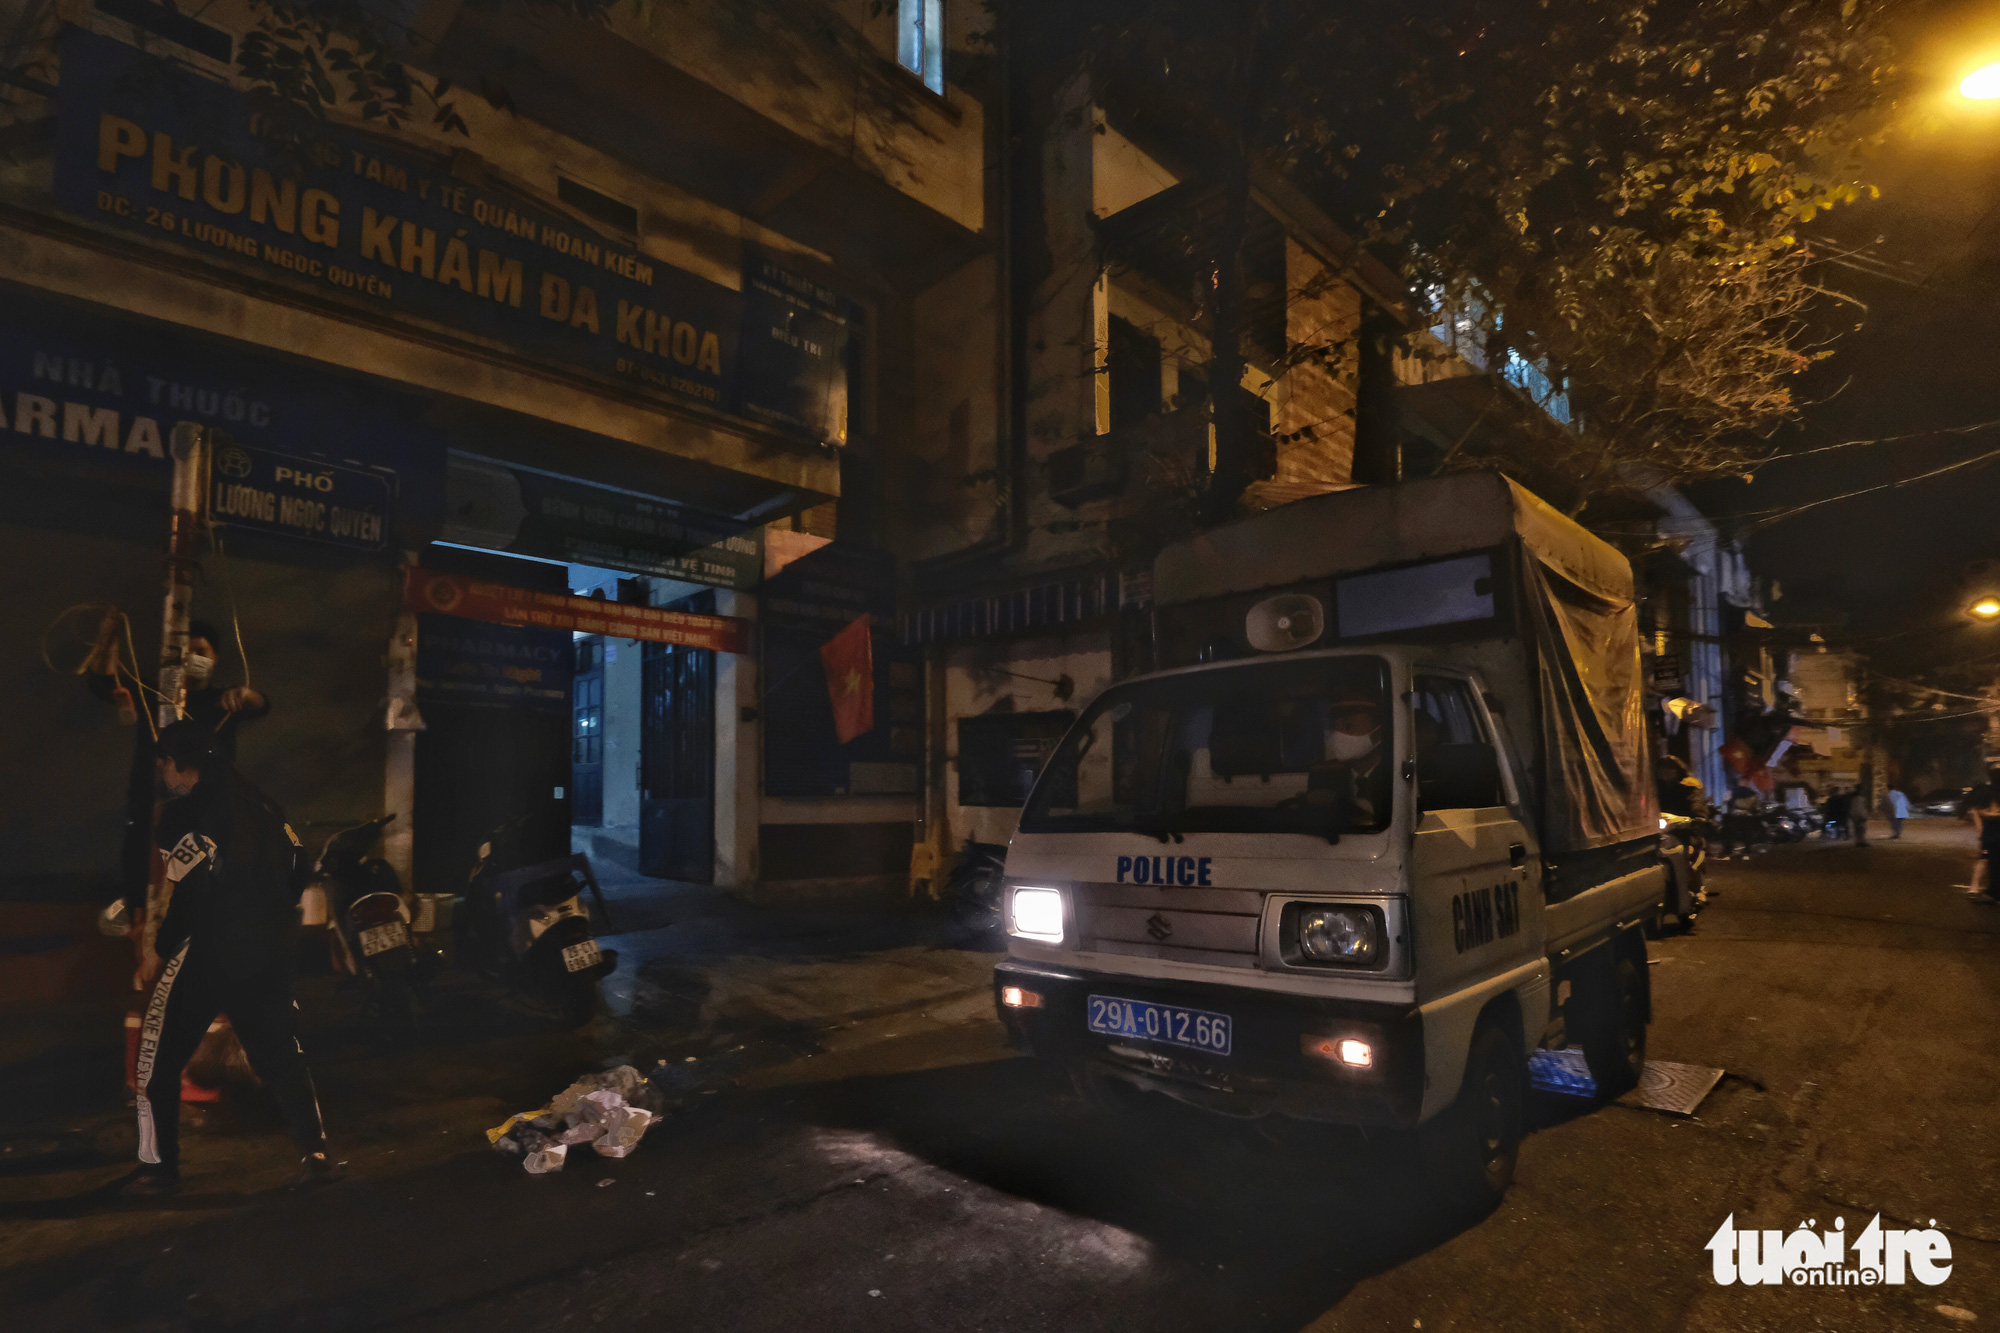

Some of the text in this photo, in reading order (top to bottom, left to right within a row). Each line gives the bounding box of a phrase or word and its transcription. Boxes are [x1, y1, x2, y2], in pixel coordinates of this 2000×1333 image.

[145, 206, 175, 231] 26
[360, 206, 524, 308] KHÁM
[539, 271, 600, 336] ĐA
[616, 299, 721, 376] KHOA
[33, 351, 123, 396] NHÀ
[274, 466, 335, 493] PHỐ
[216, 482, 276, 523] LƯƠNG
[279, 494, 325, 536] NGỌC
[1117, 855, 1212, 886] POLICE
[1093, 1000, 1226, 1049] 29A-012.66
